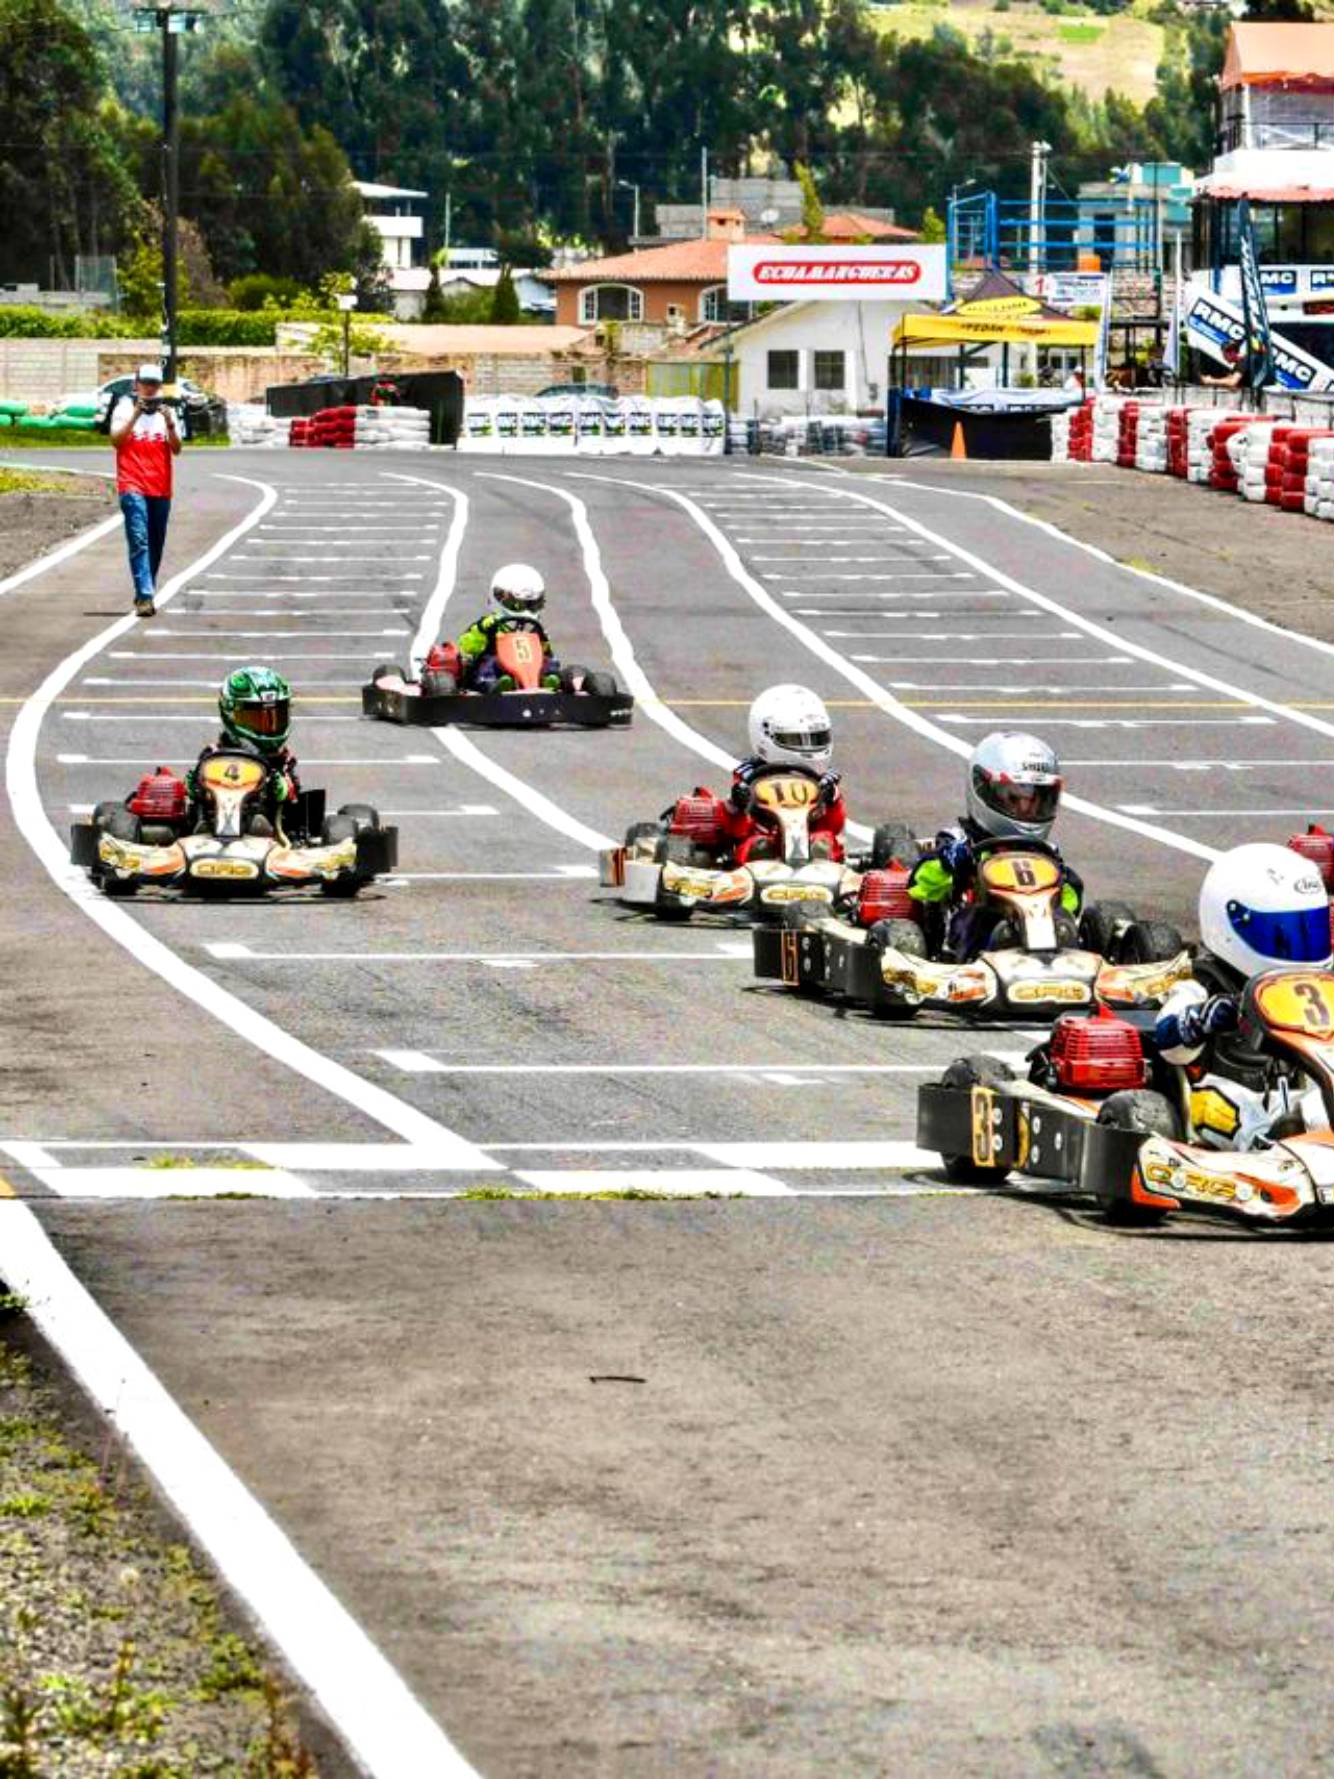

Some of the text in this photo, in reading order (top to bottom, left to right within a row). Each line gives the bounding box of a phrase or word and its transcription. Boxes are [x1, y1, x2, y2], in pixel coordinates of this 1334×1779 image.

[758, 265, 917, 281] ECUAMANGUERAS
[1260, 271, 1296, 284] MC
[1193, 304, 1246, 342] RMC
[515, 638, 530, 660] 5
[223, 764, 240, 781] 4
[773, 782, 808, 802] 10
[1011, 858, 1037, 886] 6
[1293, 982, 1331, 1027] 3
